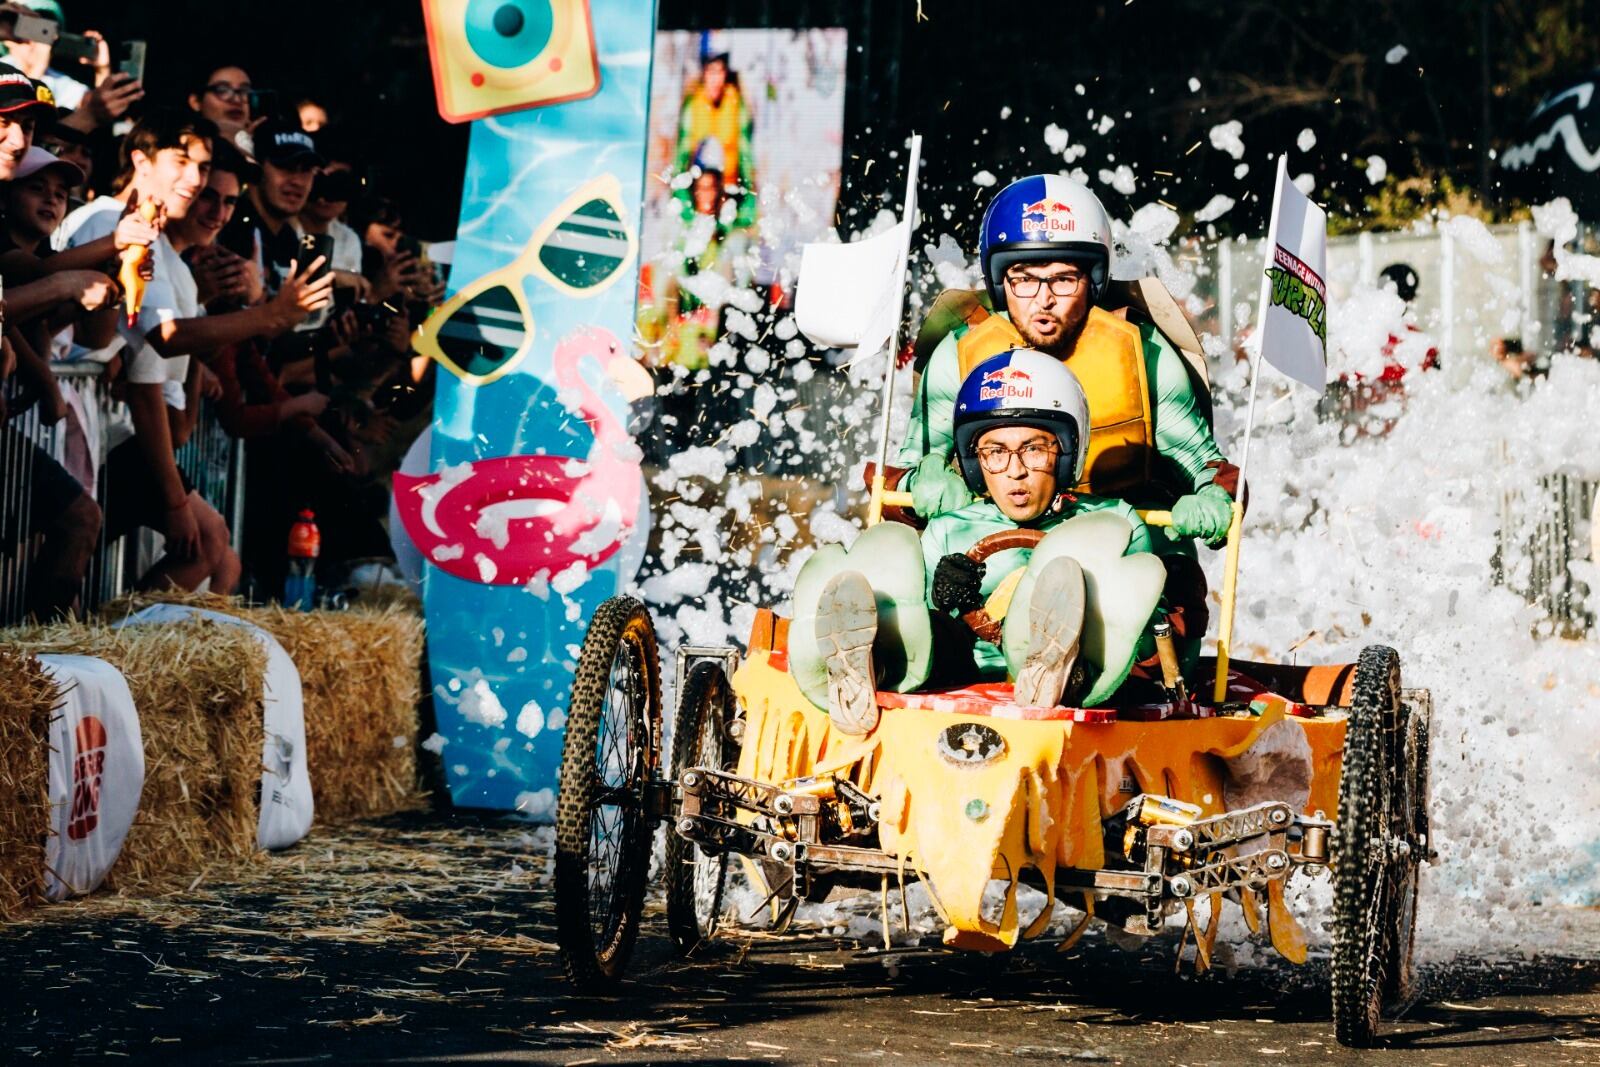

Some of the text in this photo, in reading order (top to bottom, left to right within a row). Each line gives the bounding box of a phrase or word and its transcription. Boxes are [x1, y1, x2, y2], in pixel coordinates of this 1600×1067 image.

[1023, 218, 1075, 232] Red Bull
[1275, 248, 1306, 281] TEENAGE
[981, 384, 1033, 399] Red Bull
